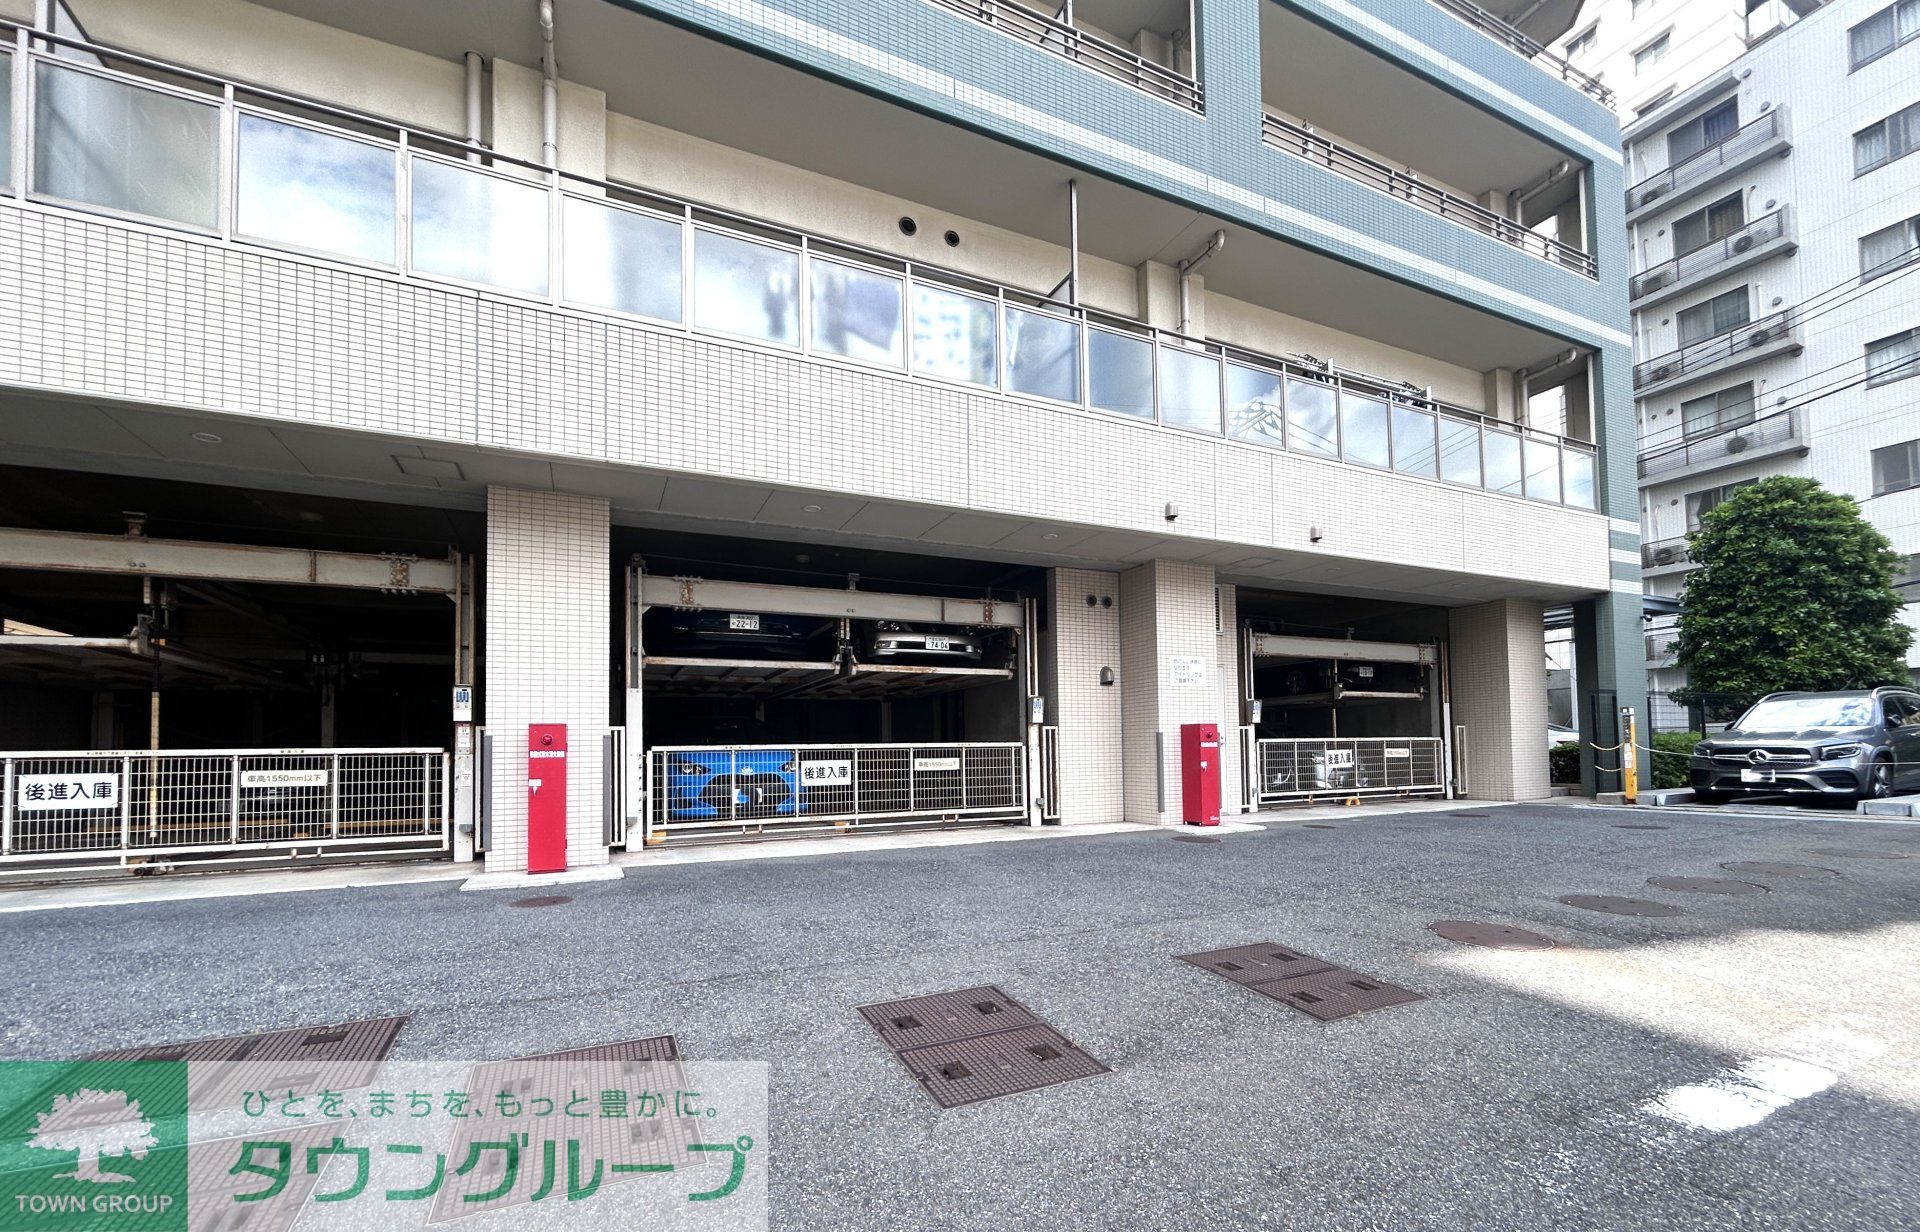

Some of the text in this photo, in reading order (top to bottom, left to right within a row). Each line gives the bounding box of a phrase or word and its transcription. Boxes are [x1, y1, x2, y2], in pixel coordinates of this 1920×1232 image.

[247, 773, 322, 784] 車高1550mm以下
[804, 765, 849, 779] 後進入庫
[25, 781, 113, 801] 後進入庫
